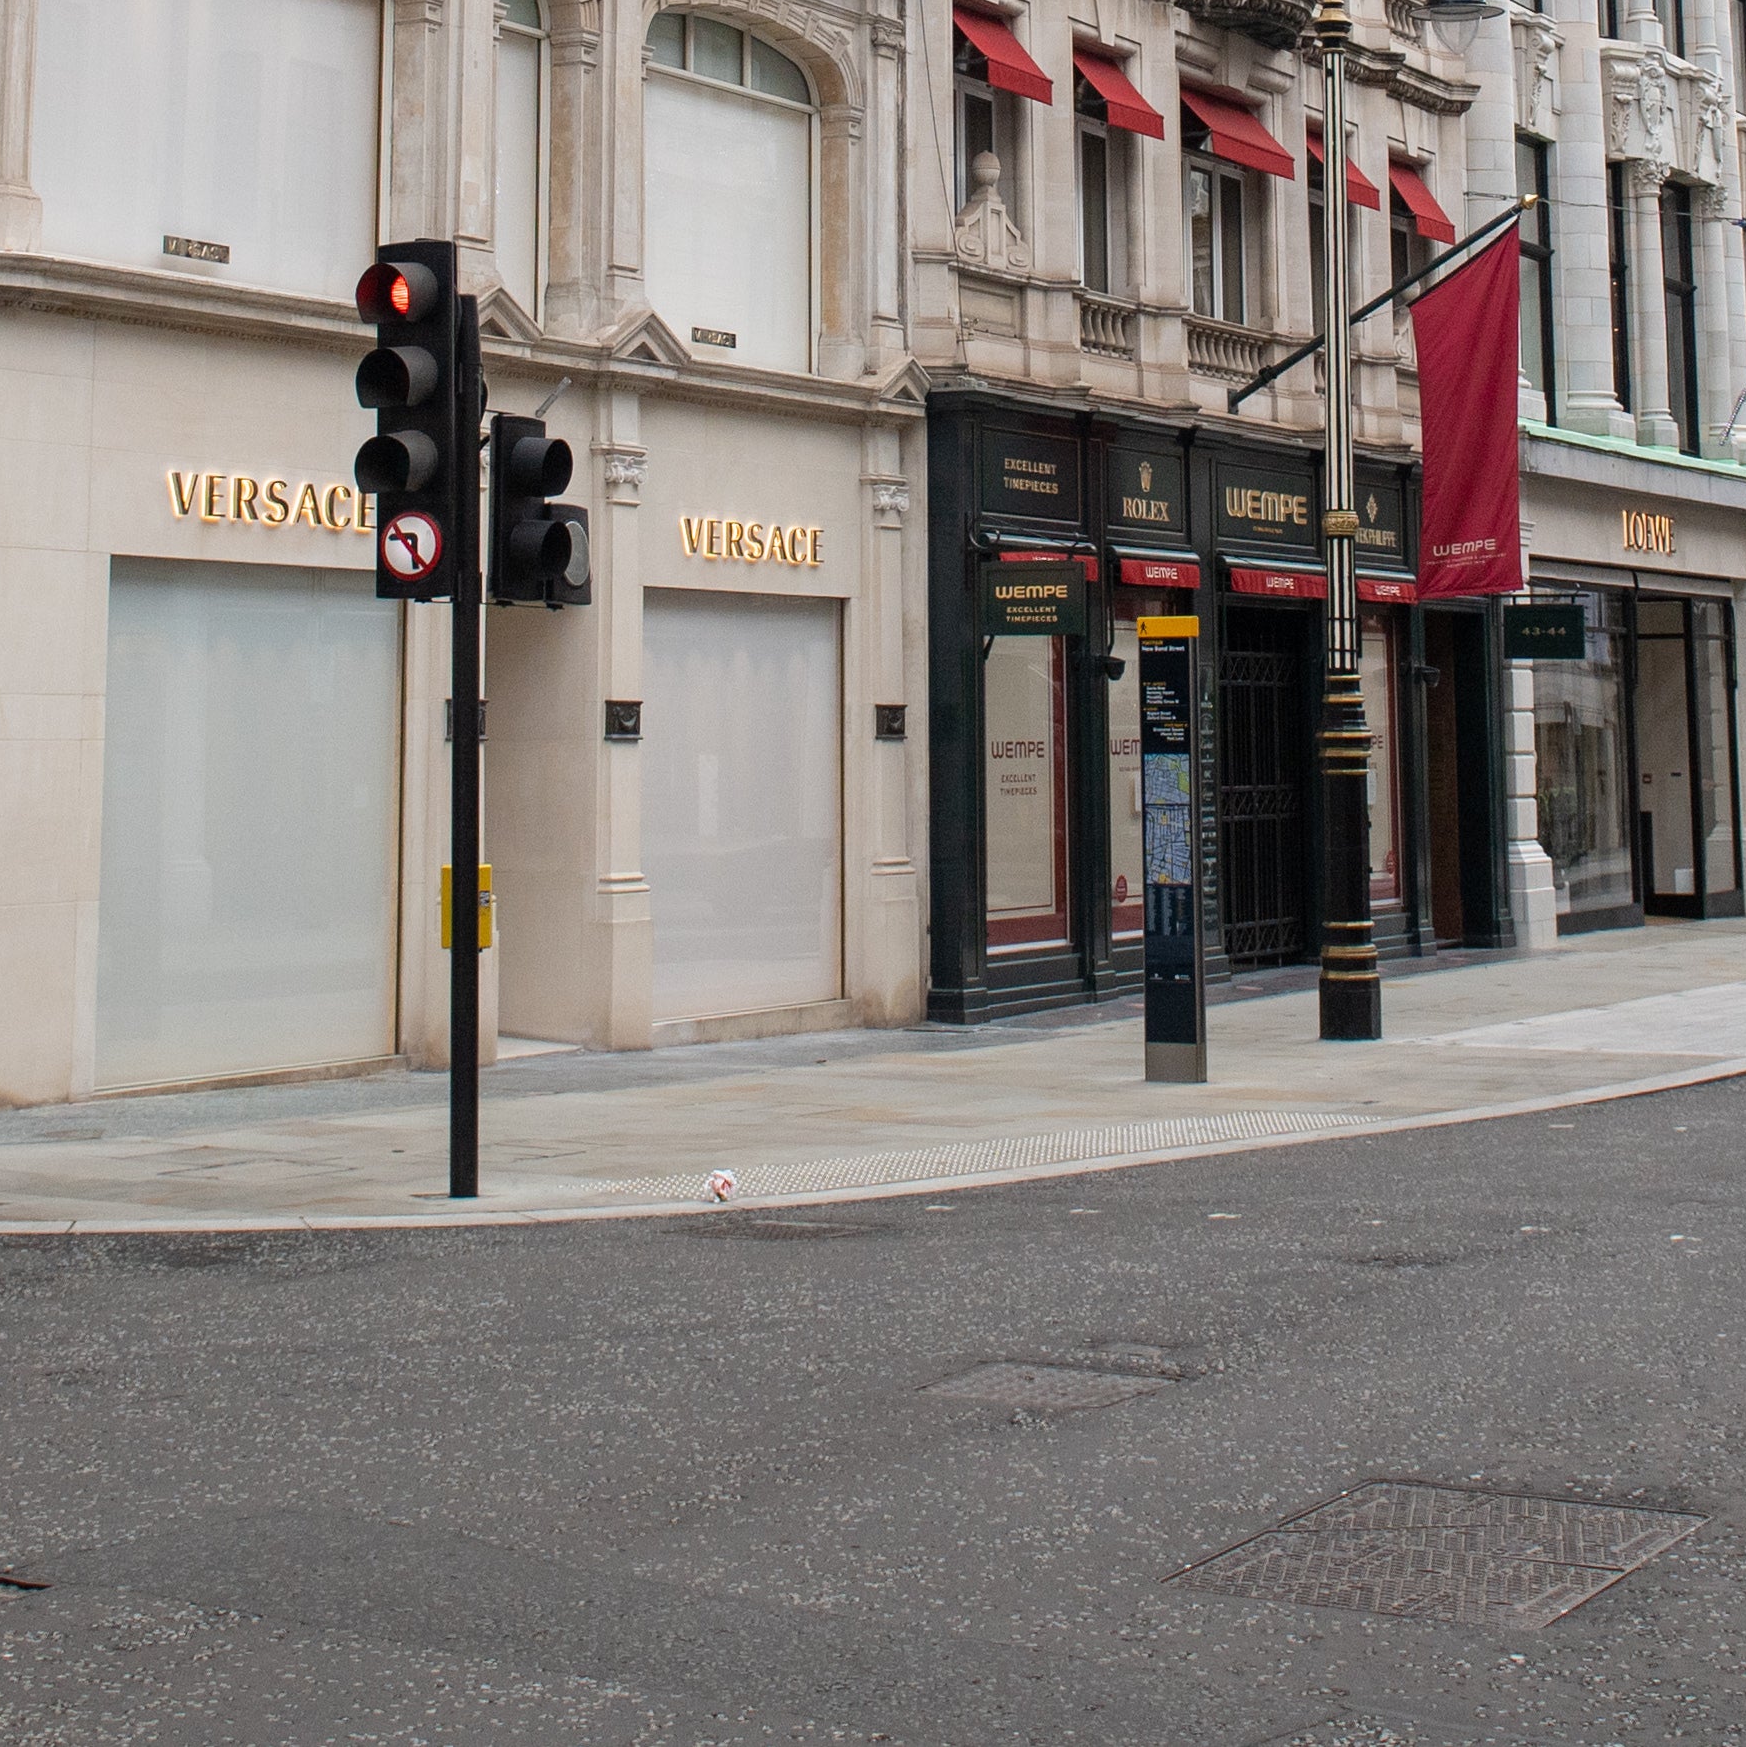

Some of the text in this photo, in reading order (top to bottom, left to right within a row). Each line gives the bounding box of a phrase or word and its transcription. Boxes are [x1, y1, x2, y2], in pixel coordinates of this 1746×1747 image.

[1004, 457, 1057, 475] EXCELLENT
[1003, 476, 1059, 495] TIMEPIECES
[167, 470, 377, 532] VERSACE
[1122, 496, 1171, 522] ROLEX
[1225, 486, 1308, 525] WEMPE
[680, 516, 825, 567] VERSACE
[1622, 509, 1676, 556] LOEWE
[1432, 538, 1497, 558] WEMPE
[1144, 566, 1178, 580] WEMPE
[995, 584, 1068, 599] WEMPE
[1266, 576, 1295, 590] WEMPE
[1374, 585, 1401, 597] WEMPE
[1006, 606, 1056, 614] EXCELLENT
[1006, 615, 1058, 623] TIMEPIECES
[991, 740, 1045, 759] WEMPE
